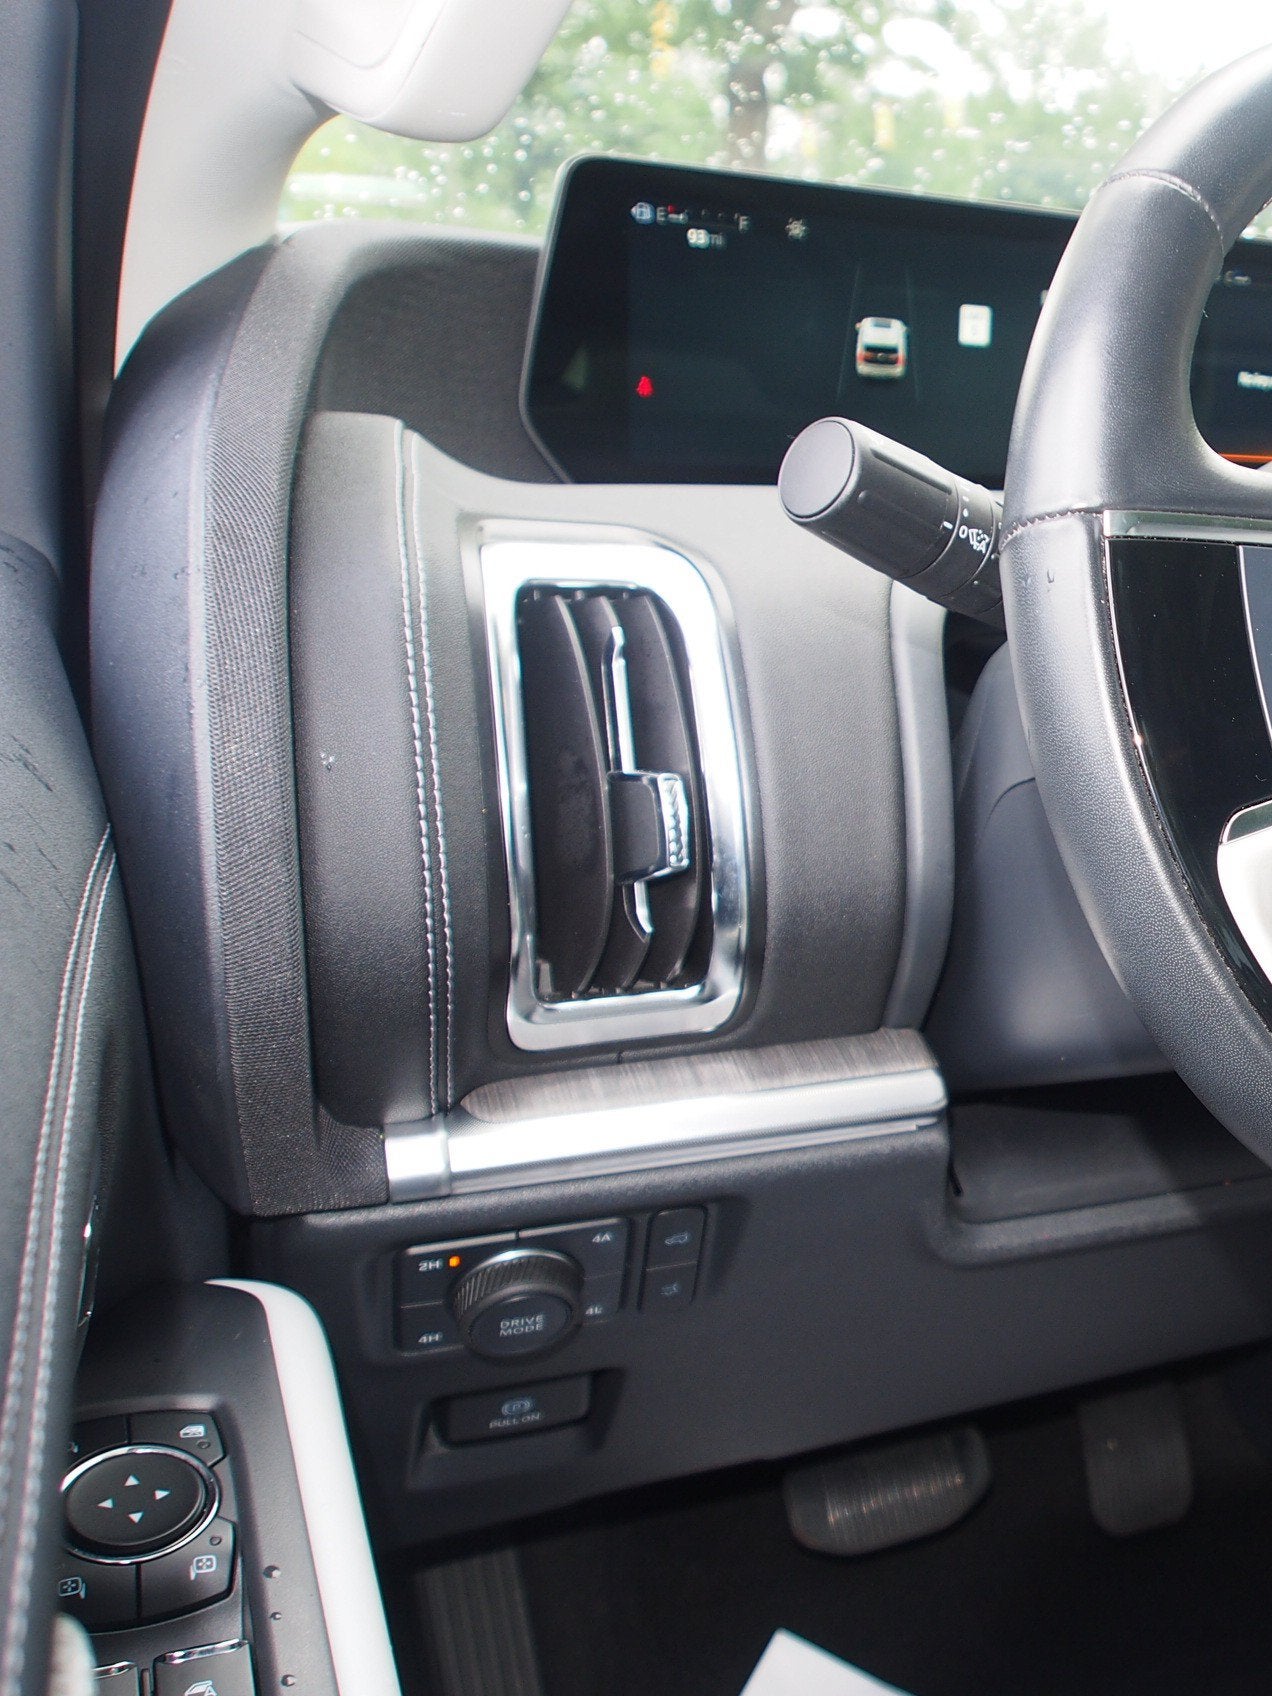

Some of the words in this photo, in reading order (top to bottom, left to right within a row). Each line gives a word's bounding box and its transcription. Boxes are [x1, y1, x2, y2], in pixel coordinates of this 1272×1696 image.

[686, 227, 710, 248] 93
[592, 1232, 613, 1244] 4A
[418, 1259, 443, 1272] 2H
[500, 1314, 544, 1329] DRIVE
[499, 1323, 544, 1337] MODE
[418, 1332, 443, 1345] 4H
[521, 1412, 541, 1424] ON
